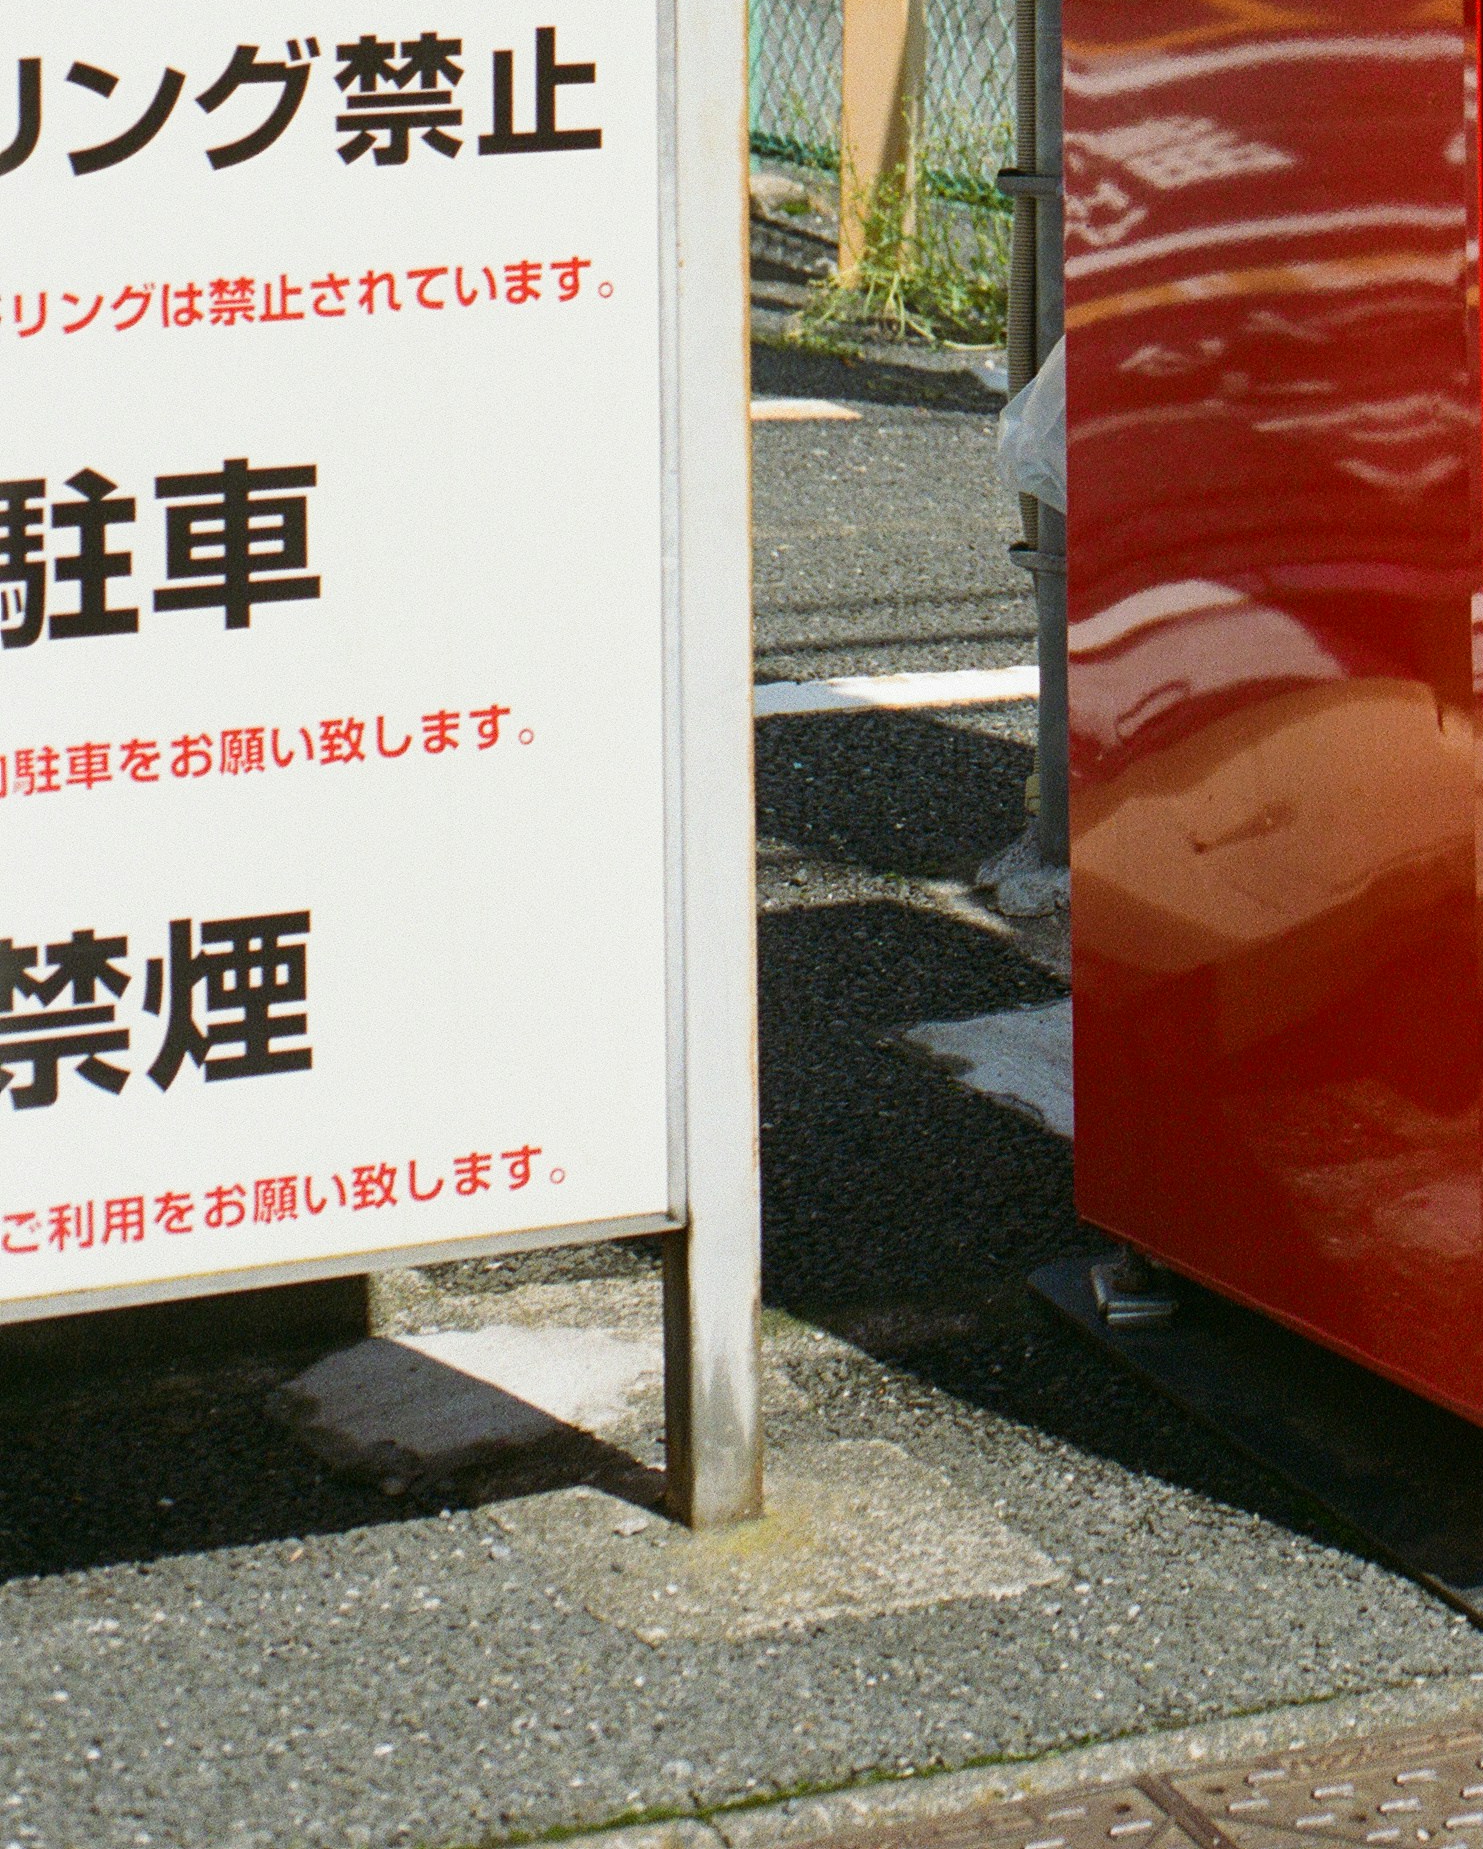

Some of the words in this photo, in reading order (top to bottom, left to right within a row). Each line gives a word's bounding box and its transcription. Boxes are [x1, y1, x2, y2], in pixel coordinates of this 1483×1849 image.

[0, 256, 614, 338] リングは禁止されています。
[0, 704, 536, 799] 駐車をお願い致します。
[0, 909, 314, 1112] 禁煙
[0, 1143, 566, 1256] ご利用をお願い致します。
